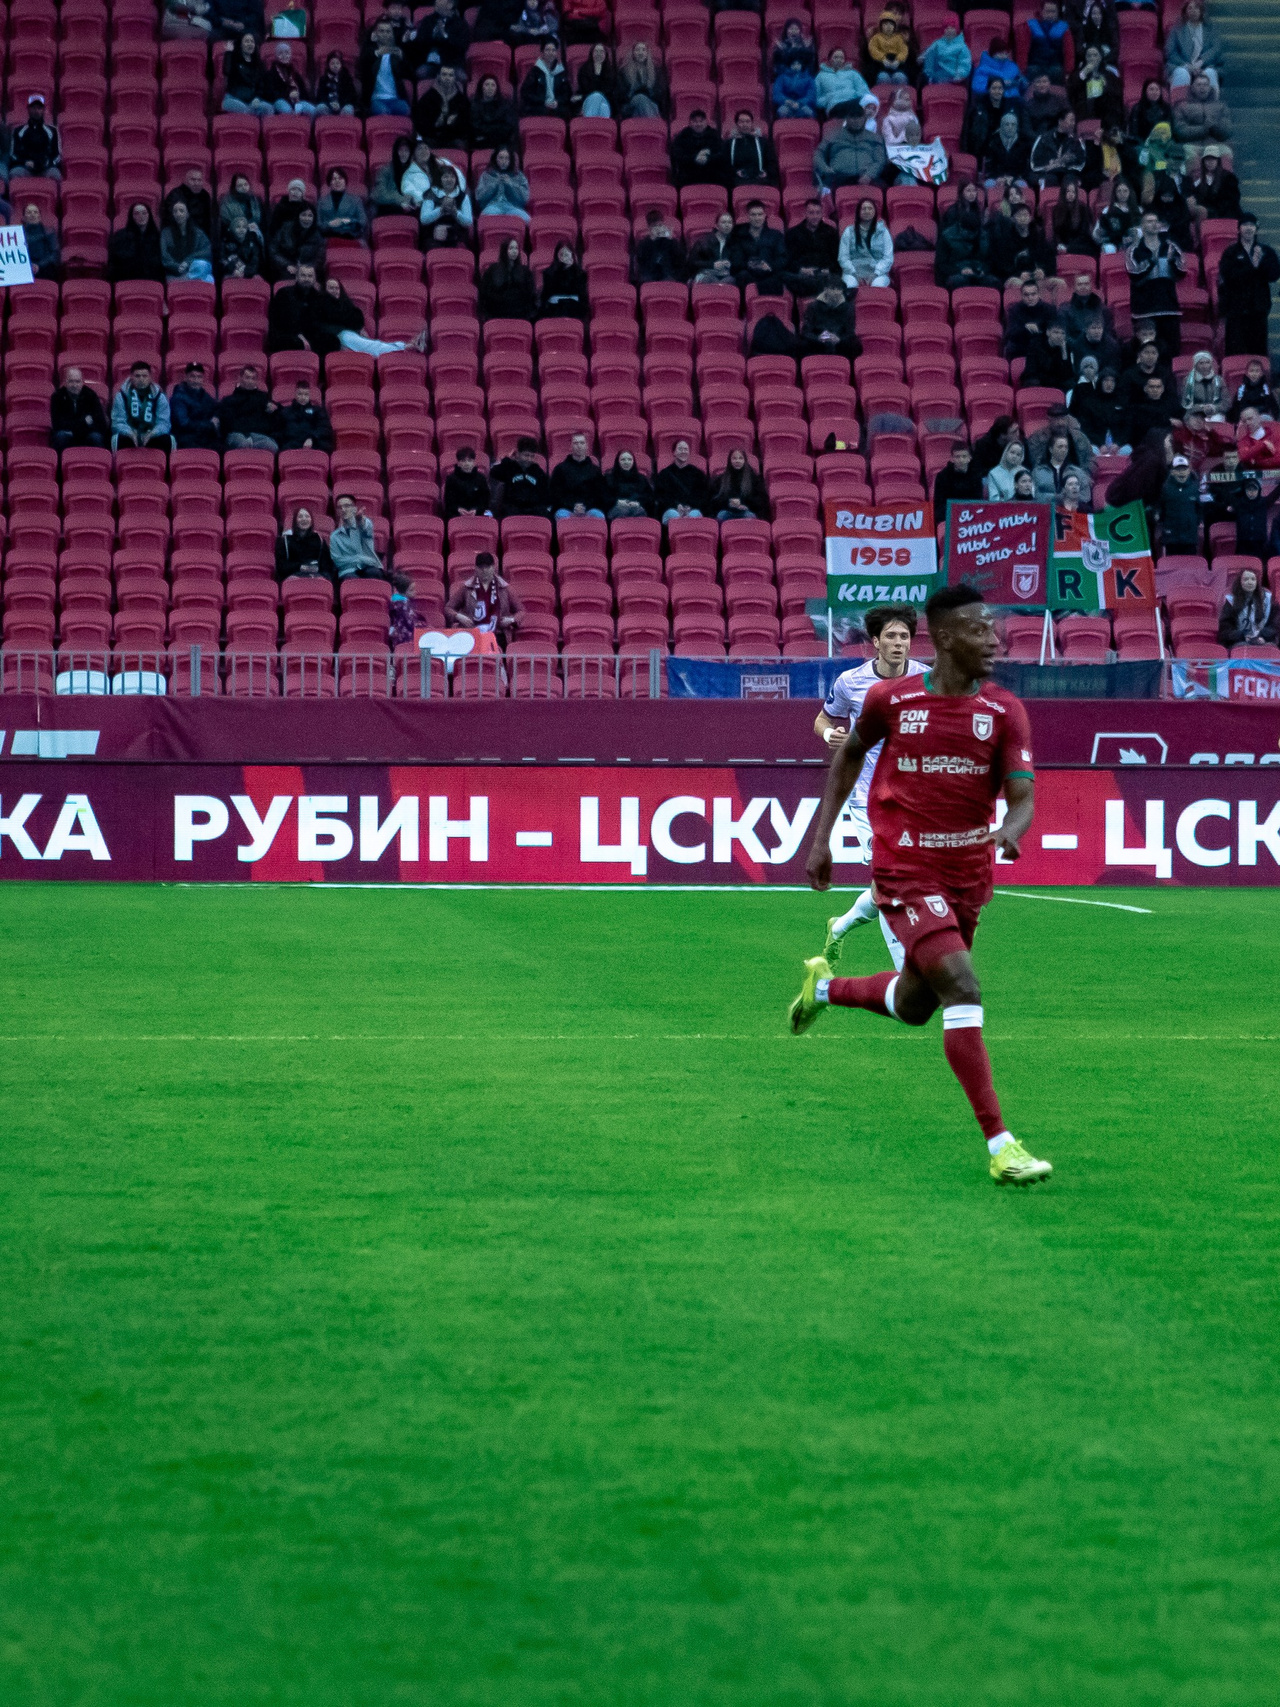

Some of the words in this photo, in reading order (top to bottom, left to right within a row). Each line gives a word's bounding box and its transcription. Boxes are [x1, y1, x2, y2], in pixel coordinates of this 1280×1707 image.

[836, 510, 924, 532] RUBIN
[958, 521, 996, 539] это
[1055, 513, 1073, 541] F
[1107, 513, 1136, 543] C
[957, 537, 991, 555] ты
[850, 546, 911, 567] 1958
[975, 547, 1014, 566] это
[837, 583, 928, 603] KAZAN
[1056, 568, 1085, 601] R
[1114, 568, 1147, 600] K
[899, 709, 930, 722] FON
[899, 721, 929, 734] BET
[174, 795, 489, 862] РУБИН
